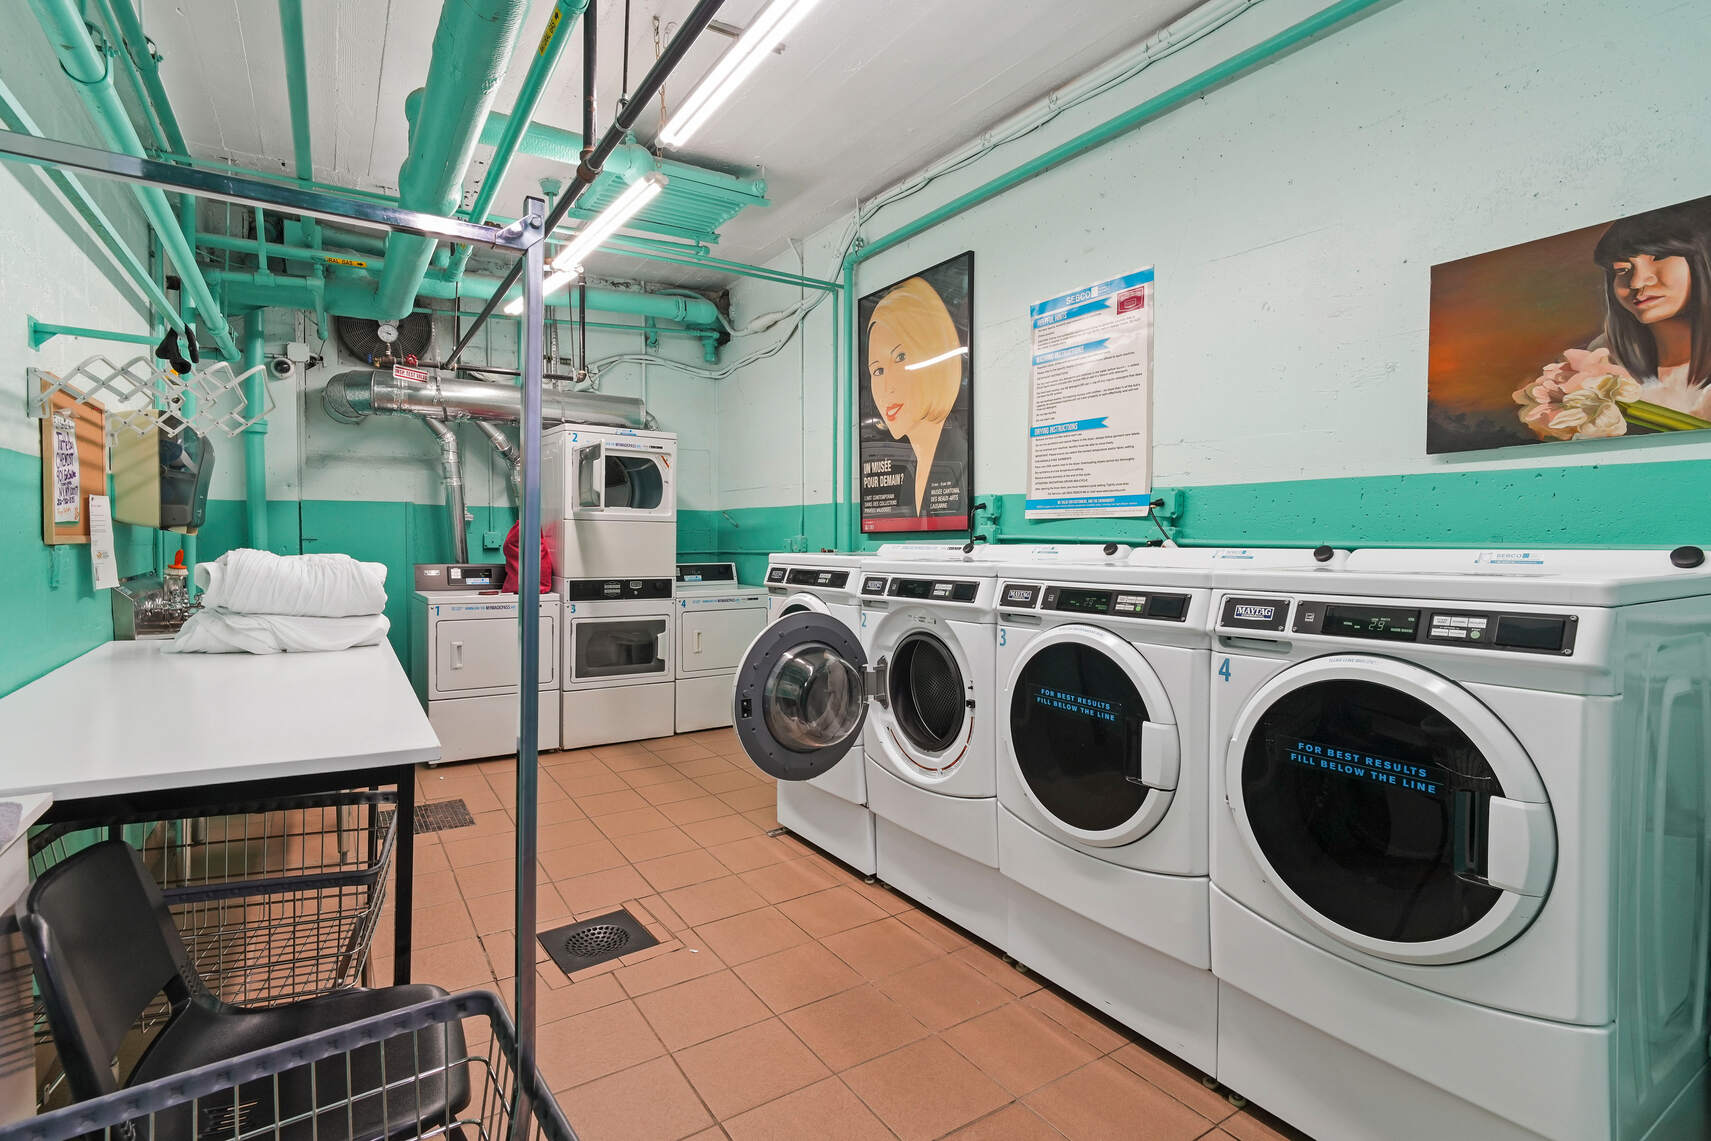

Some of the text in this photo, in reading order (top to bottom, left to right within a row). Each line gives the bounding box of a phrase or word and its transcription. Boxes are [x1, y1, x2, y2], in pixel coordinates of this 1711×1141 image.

[1066, 291, 1091, 304] SEBCO
[1049, 422, 1078, 434] INSTRUCTIONS
[572, 433, 578, 443] 2
[863, 457, 892, 474] UN MUSÉE
[863, 476, 879, 488] POUR
[570, 604, 576, 613] 3
[681, 600, 687, 608] 4
[435, 606, 440, 616] 1
[1237, 606, 1273, 617] MAYTAG
[861, 613, 867, 627] 2
[1368, 621, 1386, 631] 29
[1000, 628, 1006, 646] 3
[1218, 658, 1231, 682] 4
[1041, 688, 1111, 710] FOR BEST RESULTS
[1036, 697, 1116, 721] FILL BELOW THE LINE
[1298, 742, 1427, 777] FOR BEST RESULTS
[1291, 753, 1436, 794] FILL BELOW THE LINE
